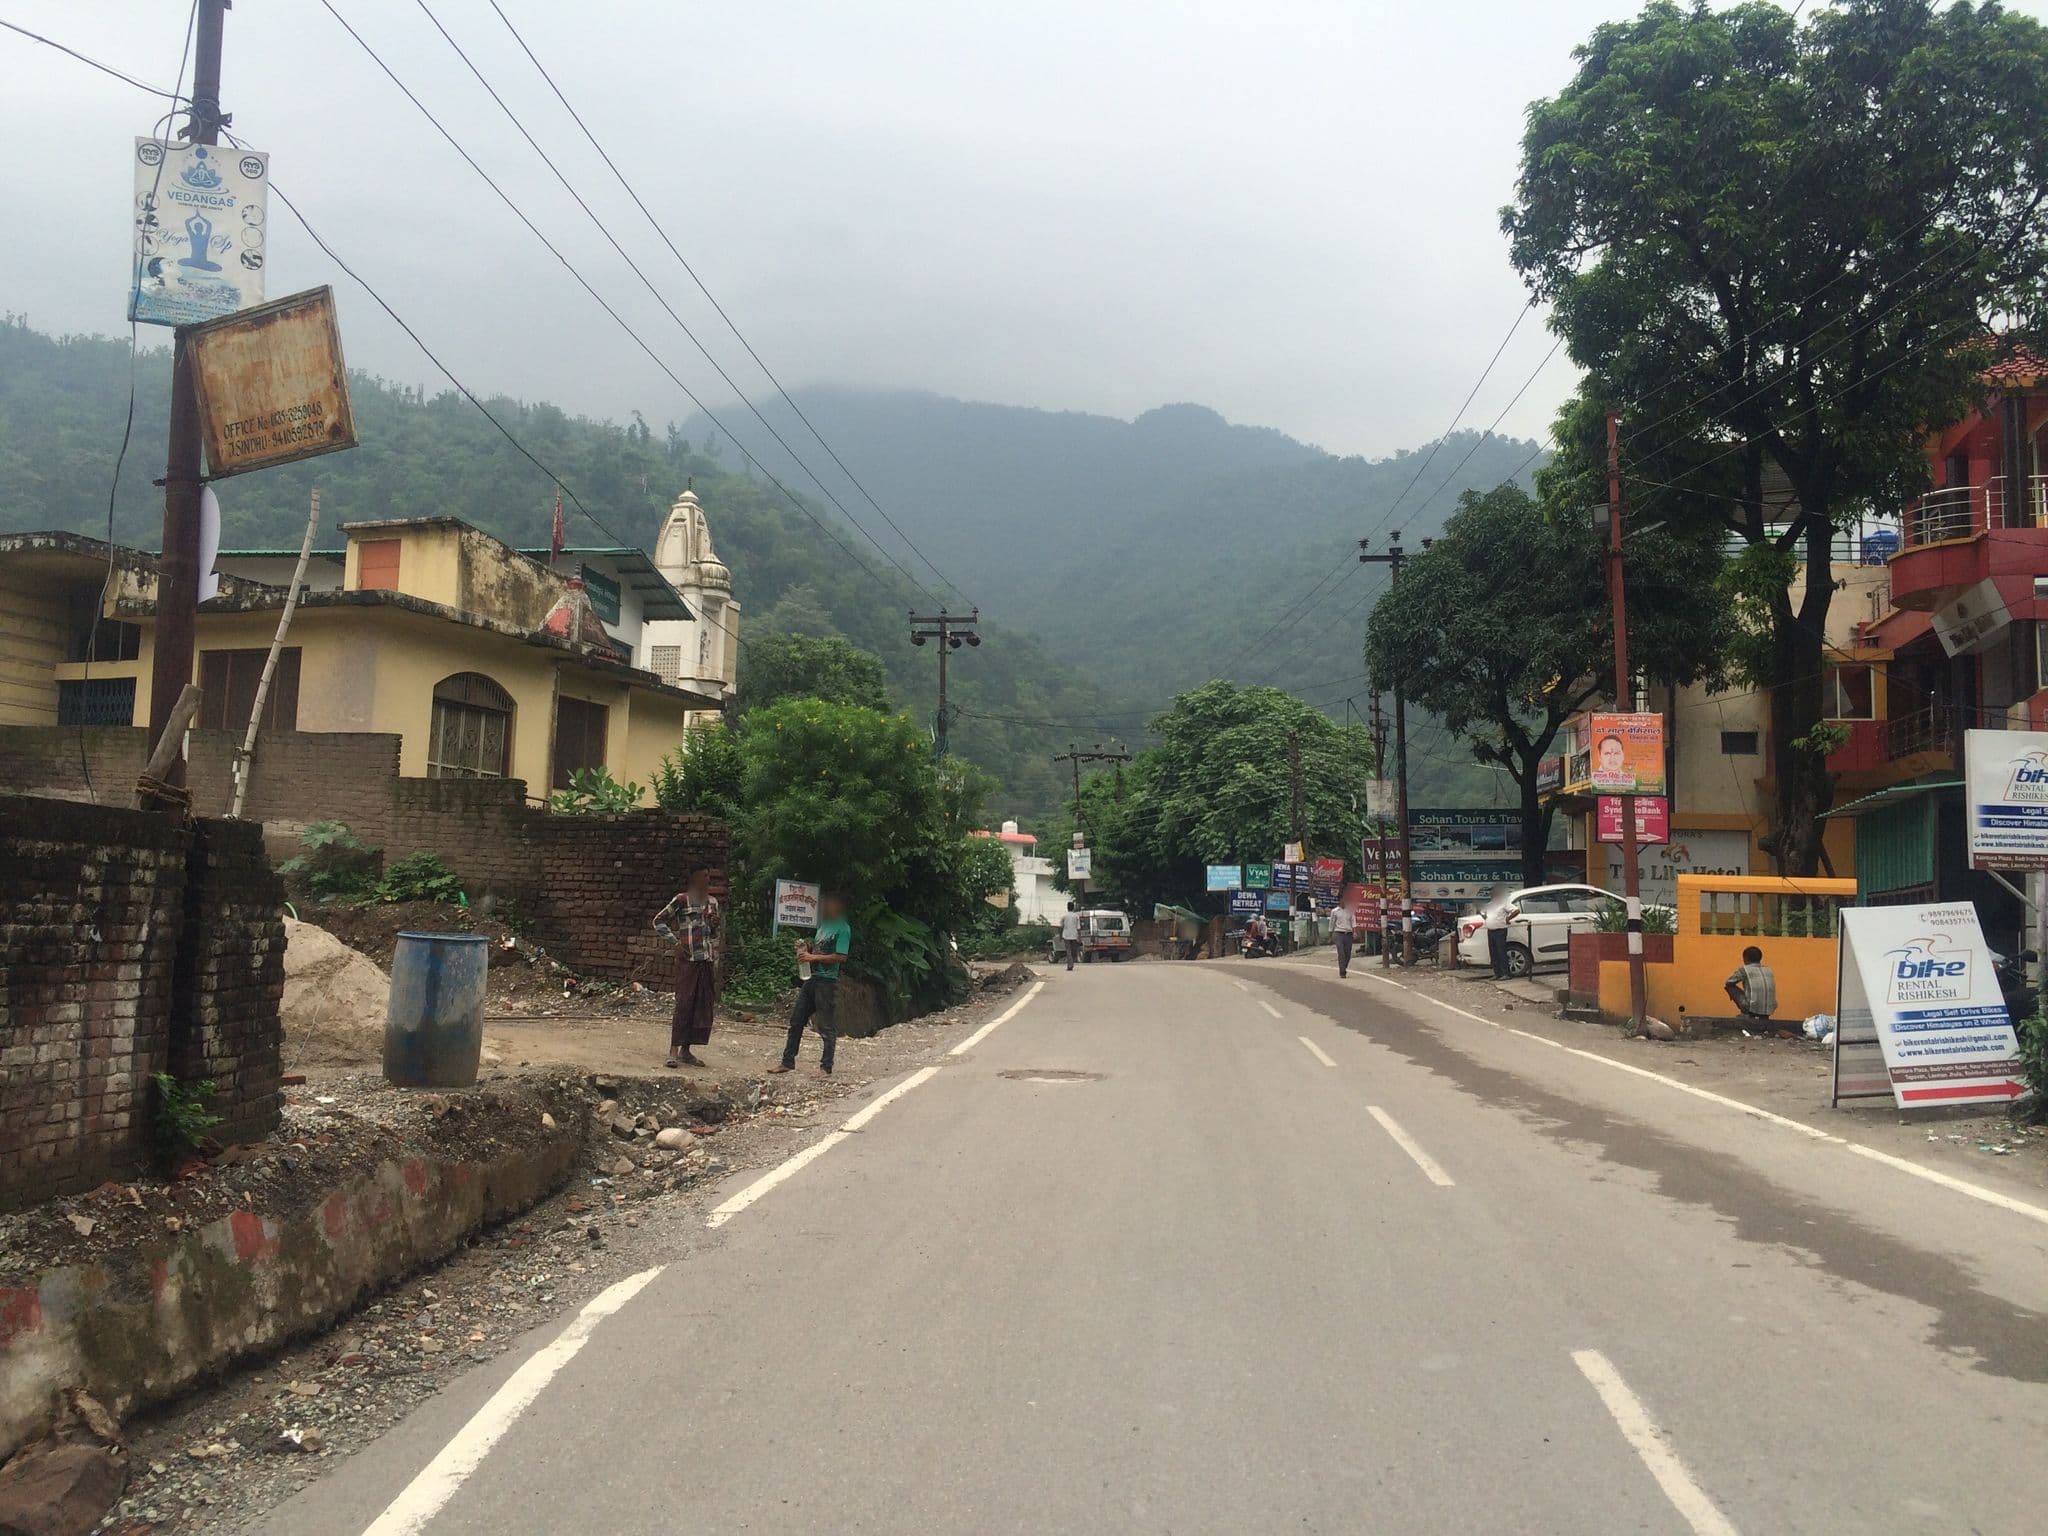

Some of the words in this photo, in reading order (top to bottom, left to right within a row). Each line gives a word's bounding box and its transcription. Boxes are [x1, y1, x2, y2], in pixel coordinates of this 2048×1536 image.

[243, 161, 260, 170] RYS
[167, 190, 234, 208] VEDANGAS
[223, 418, 254, 440] OFFICE
[2014, 783, 2046, 792] RENTAL
[2022, 806, 2042, 817] Legal
[1419, 814, 1453, 824] Sohan
[1454, 814, 1485, 824] Tours
[1488, 815, 1497, 824] &
[1990, 818, 2022, 828] Discover
[1248, 868, 1269, 877] VYAS
[1420, 871, 1454, 881] Sohan
[1456, 871, 1488, 881] Tours
[1491, 872, 1500, 880] &
[1237, 891, 1257, 899] DEWA
[1232, 899, 1262, 907] RETREAT
[1897, 959, 1966, 979] bike
[1898, 980, 1942, 991] RENTAL
[1898, 989, 1957, 1001] RISHIKESH
[1922, 1010, 1943, 1019] Legal
[1944, 1009, 1959, 1017] Self
[1960, 1007, 1981, 1016] Drive
[1981, 1006, 2003, 1015] Bikes
[1895, 1022, 1926, 1031] Discover
[1926, 1020, 1963, 1029] Himalayas
[1974, 1018, 1980, 1026] 2
[1981, 1017, 2006, 1026] Wheels
